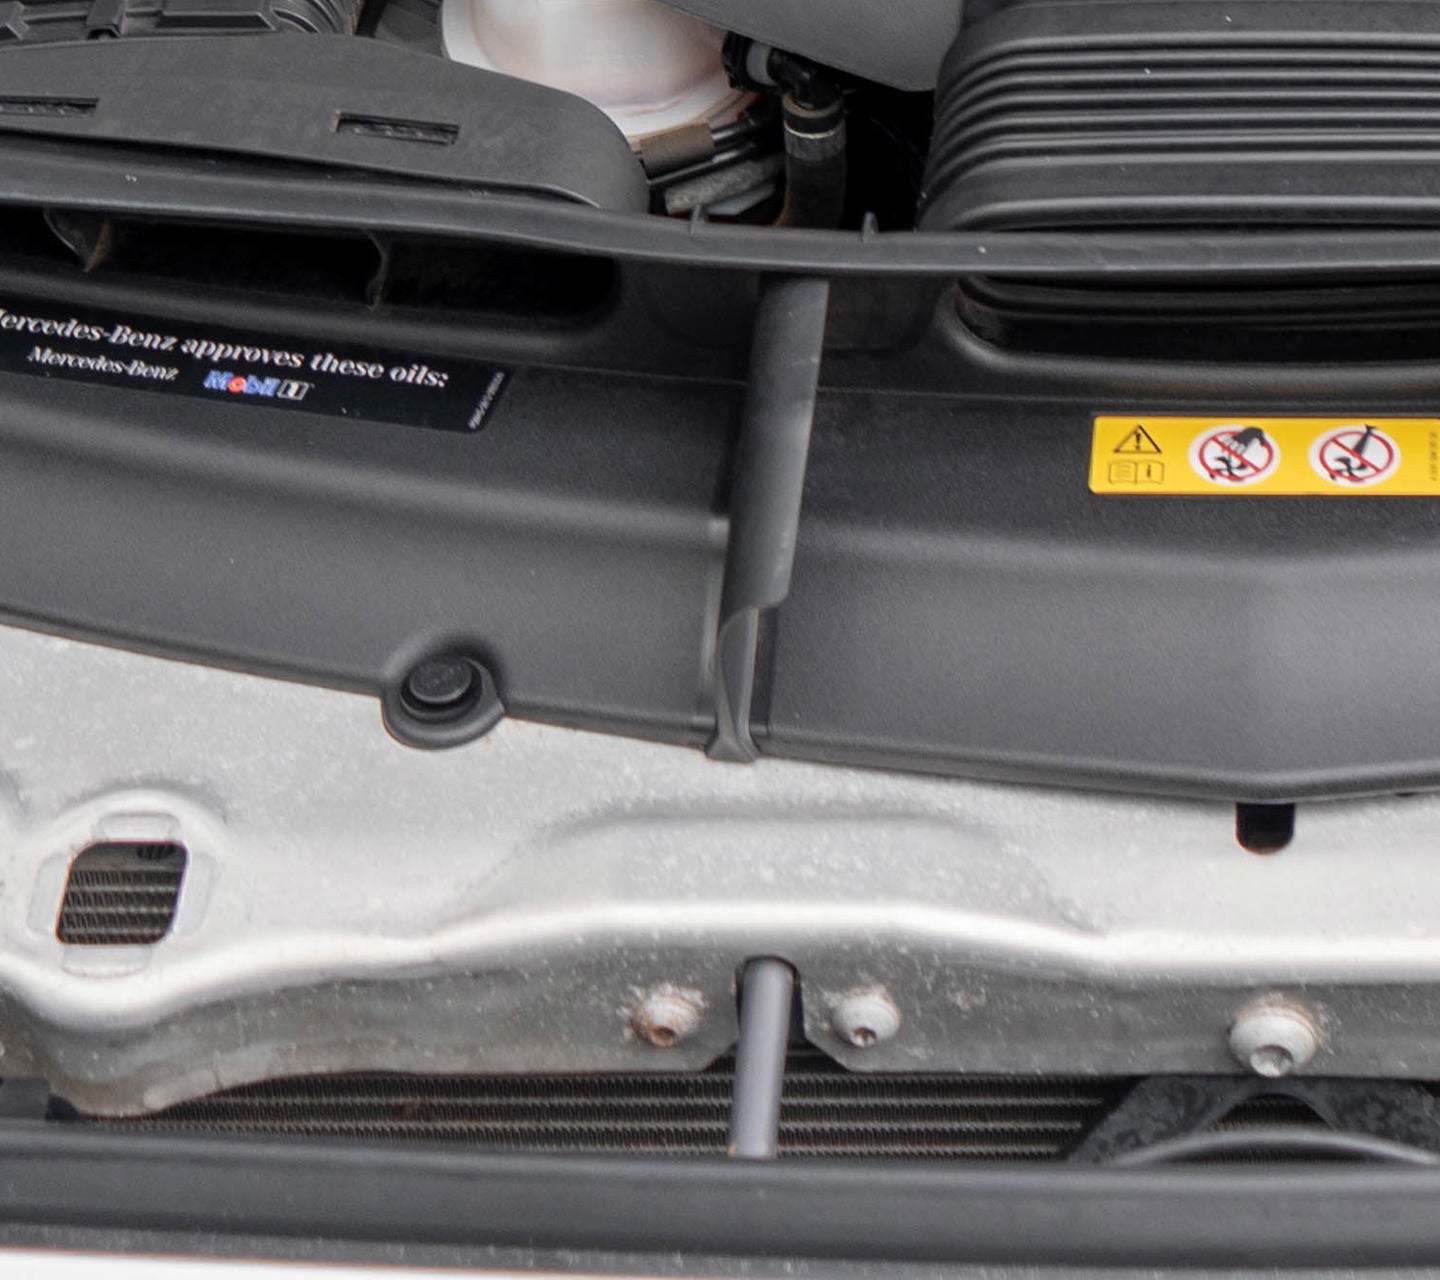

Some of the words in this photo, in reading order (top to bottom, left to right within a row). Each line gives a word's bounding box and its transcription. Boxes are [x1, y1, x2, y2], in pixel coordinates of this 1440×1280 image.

[27, 345, 178, 382] Mercedes-Benz
[180, 338, 305, 369] approves
[310, 352, 384, 380] these
[389, 363, 449, 389] oils:
